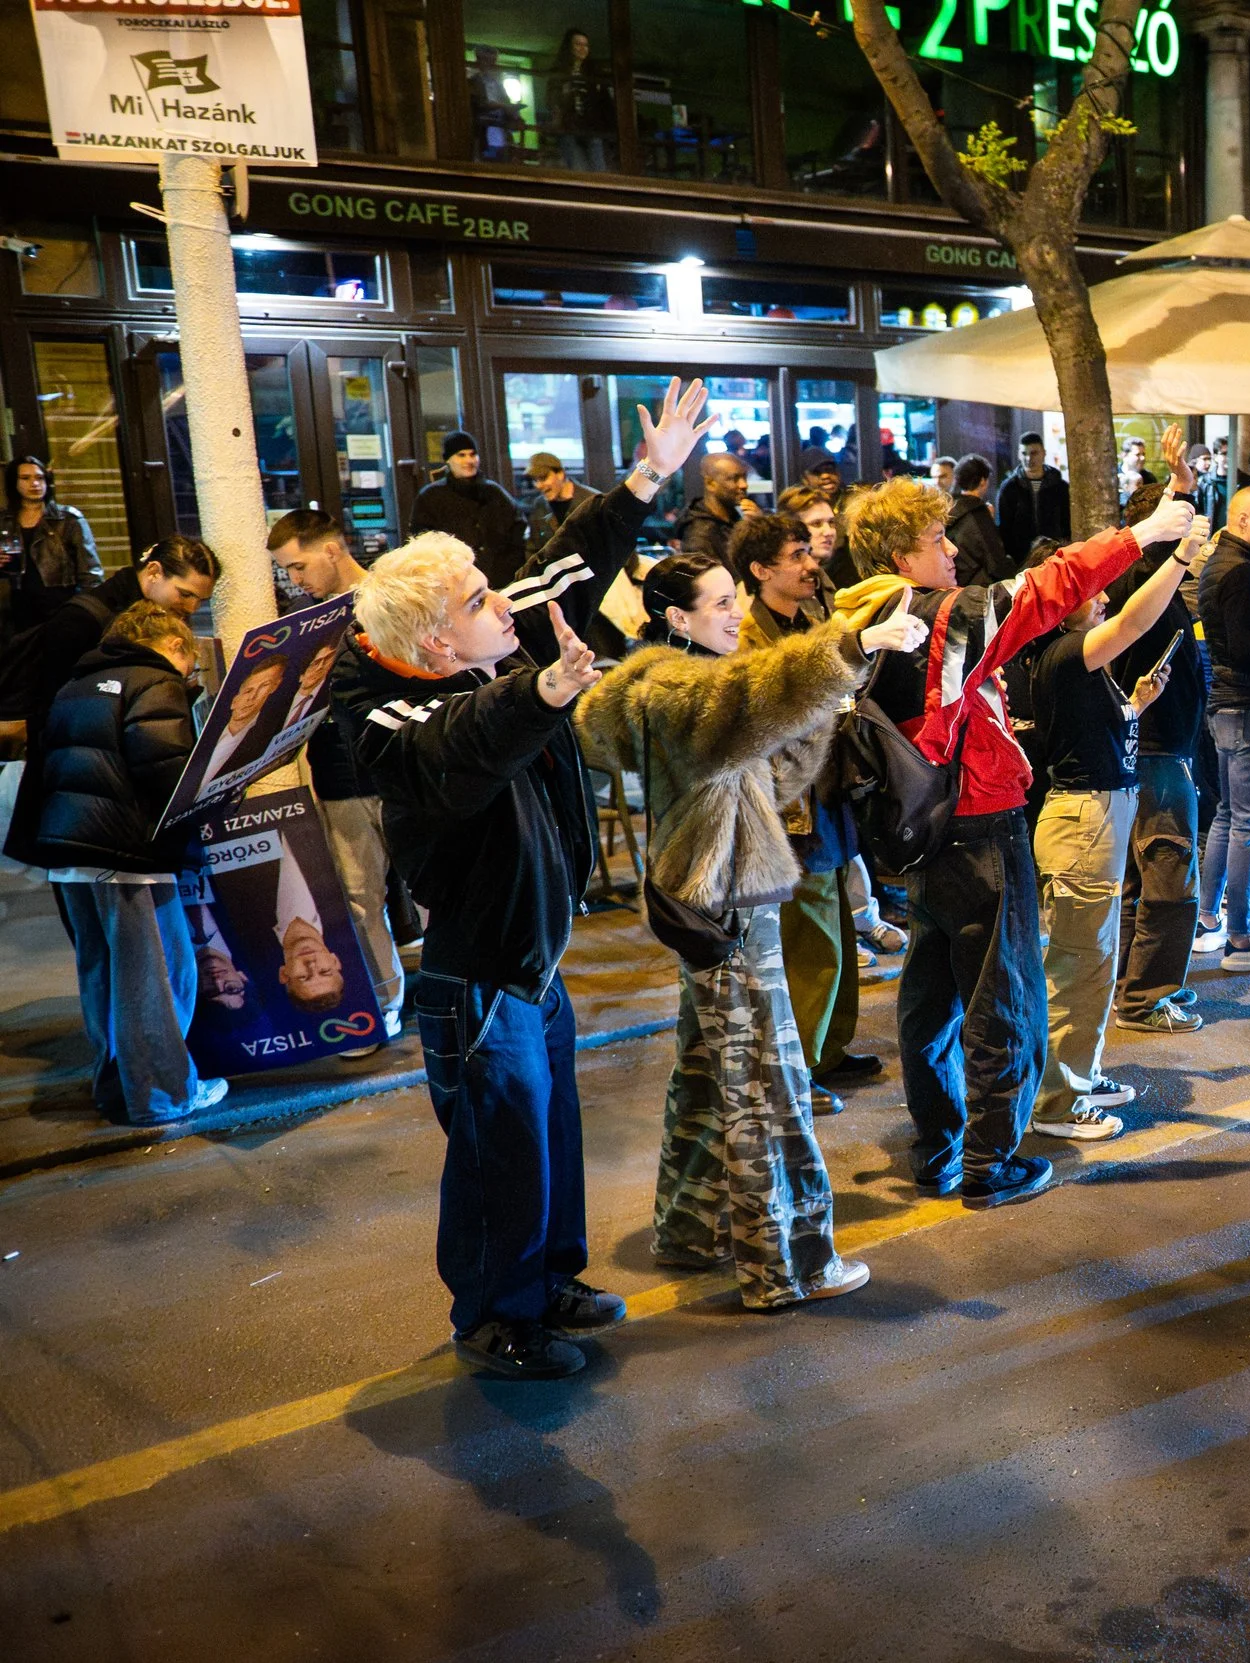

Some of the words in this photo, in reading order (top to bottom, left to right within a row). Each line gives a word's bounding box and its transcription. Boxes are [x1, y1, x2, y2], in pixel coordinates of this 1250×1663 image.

[109, 93, 144, 115] Mi
[161, 98, 257, 125] Hazánk
[288, 192, 377, 220] GONG
[385, 200, 460, 226] CAFE
[462, 217, 531, 241] 2BAR
[925, 244, 981, 267] GONG
[299, 605, 347, 635] TISZA
[223, 801, 306, 832] SZAVAZZ!
[207, 839, 271, 866] GYÖRG
[241, 1030, 313, 1057] TISZA
